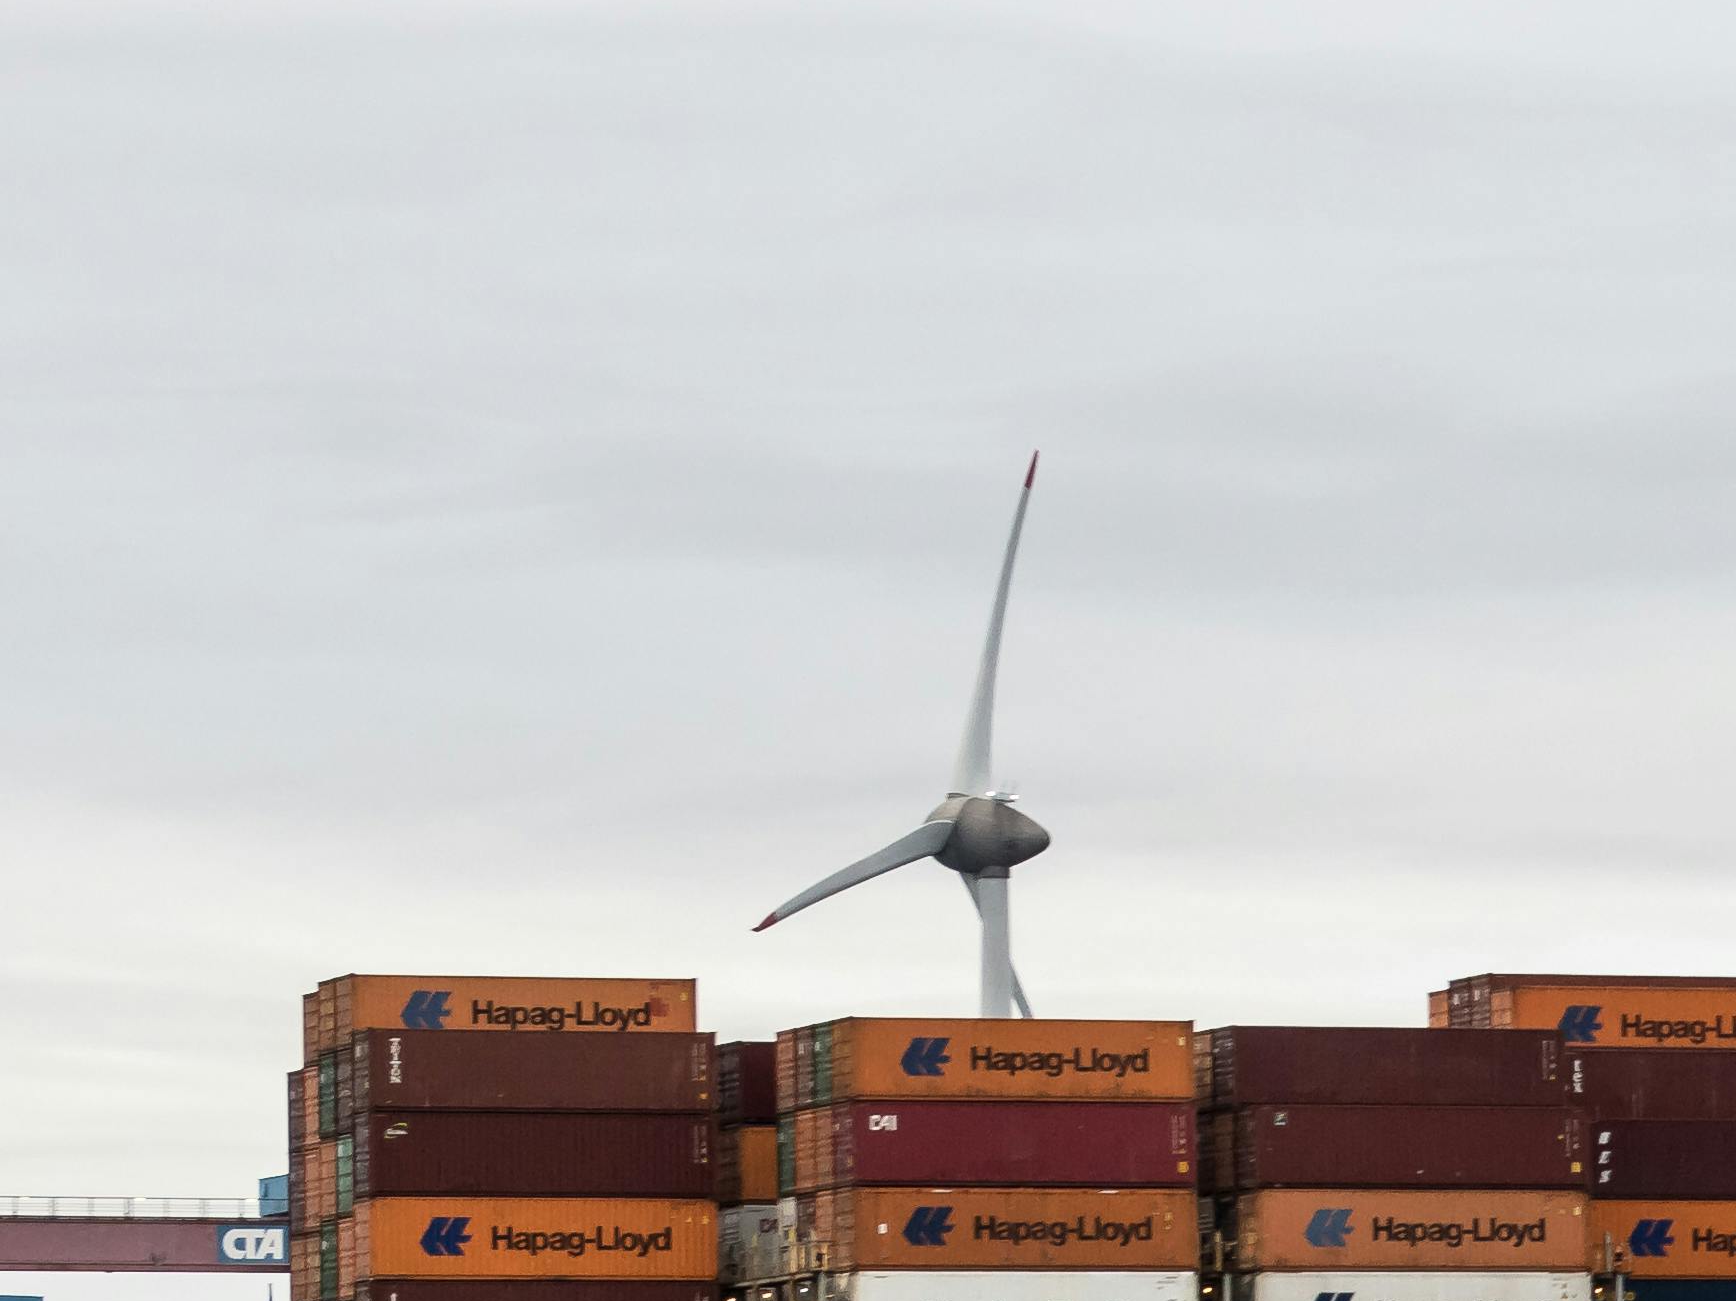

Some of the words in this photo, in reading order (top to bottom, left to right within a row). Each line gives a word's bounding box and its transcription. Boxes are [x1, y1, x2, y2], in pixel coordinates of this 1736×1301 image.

[472, 1000, 651, 1031] Hapag-Lloyd
[970, 1048, 1149, 1077] Hapag-Lloyd
[222, 1228, 284, 1260] CTA
[492, 1226, 671, 1257] Hapag-Lloyd
[974, 1216, 1152, 1246] Hapag-Lloyd
[1372, 1217, 1545, 1246] Hapag-Lloyd
